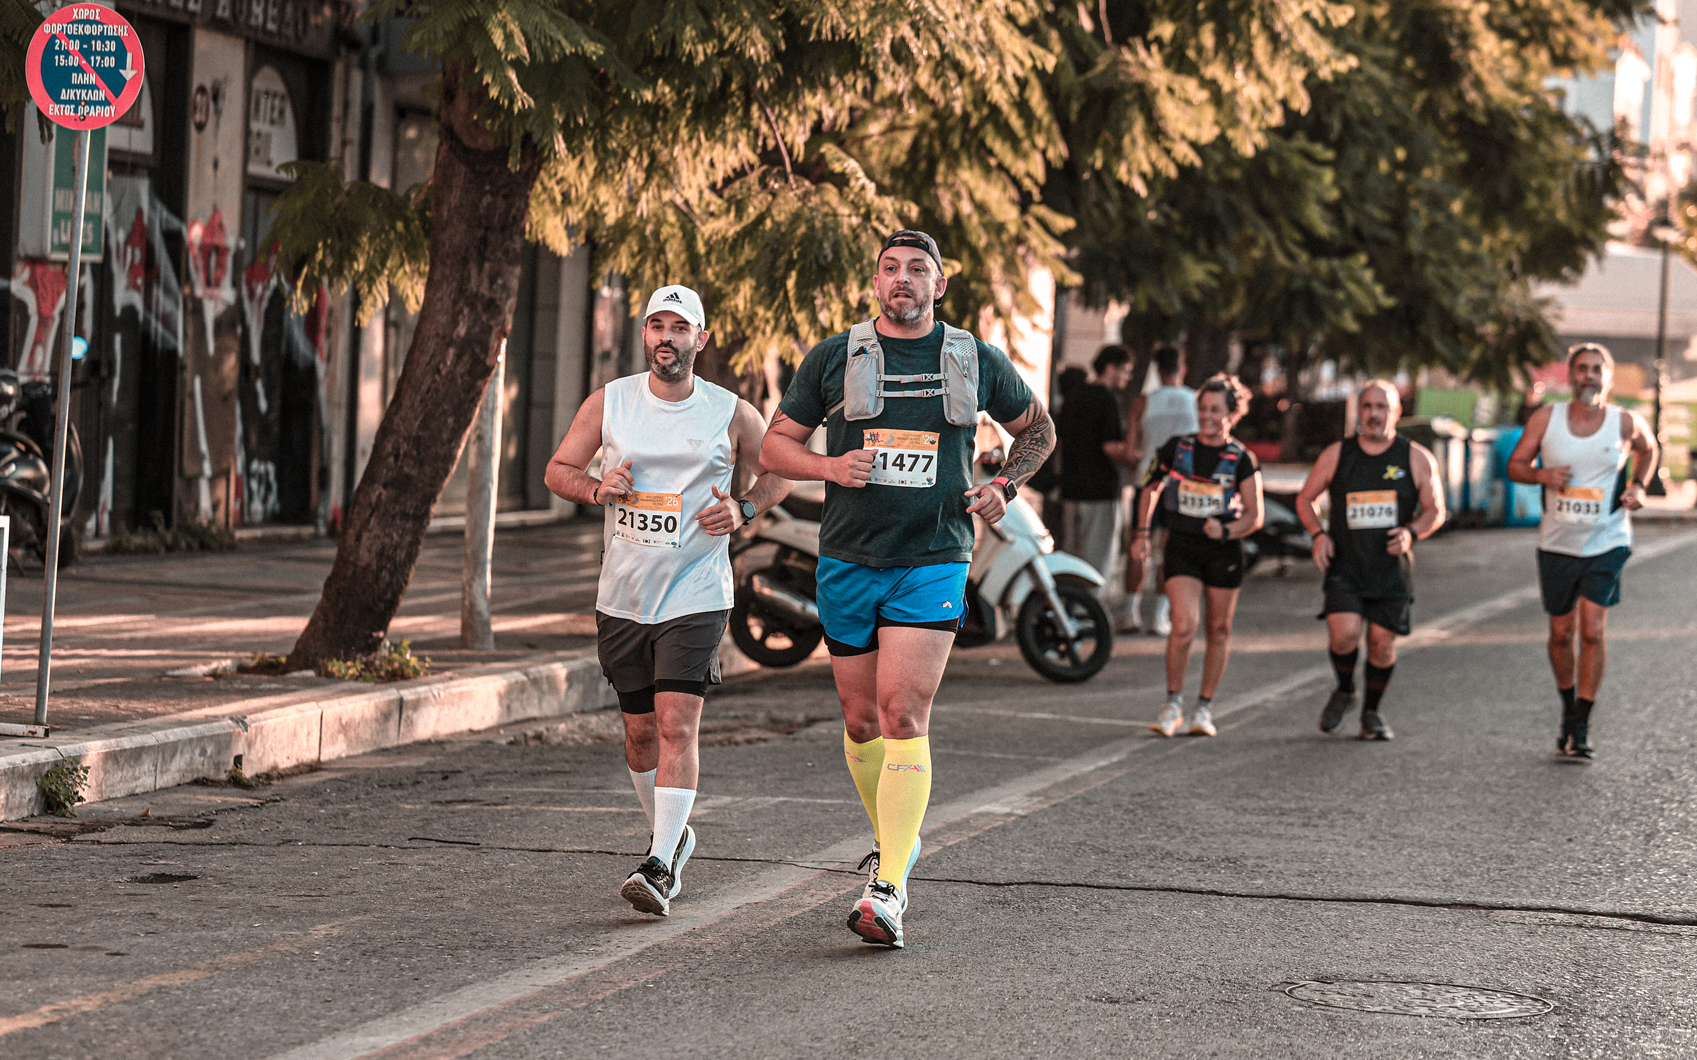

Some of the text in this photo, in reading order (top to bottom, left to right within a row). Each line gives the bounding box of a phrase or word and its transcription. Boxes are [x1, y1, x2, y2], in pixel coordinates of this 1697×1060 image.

[73, 8, 101, 19] ΧΩΡΟΣ
[44, 24, 129, 37] ΦΟΡΤΟΕΚΦΟΡΤΩΣΗΣ
[55, 40, 80, 50] 21:00
[55, 55, 79, 67] 15:00
[90, 56, 115, 67] 17:00
[71, 73, 96, 85] ΠΛΗΝ
[60, 88, 106, 101] ΔΙΚΥΚΛΩΝ
[49, 104, 75, 116] ΕΚΤΟΣ
[618, 507, 677, 533] 21350
